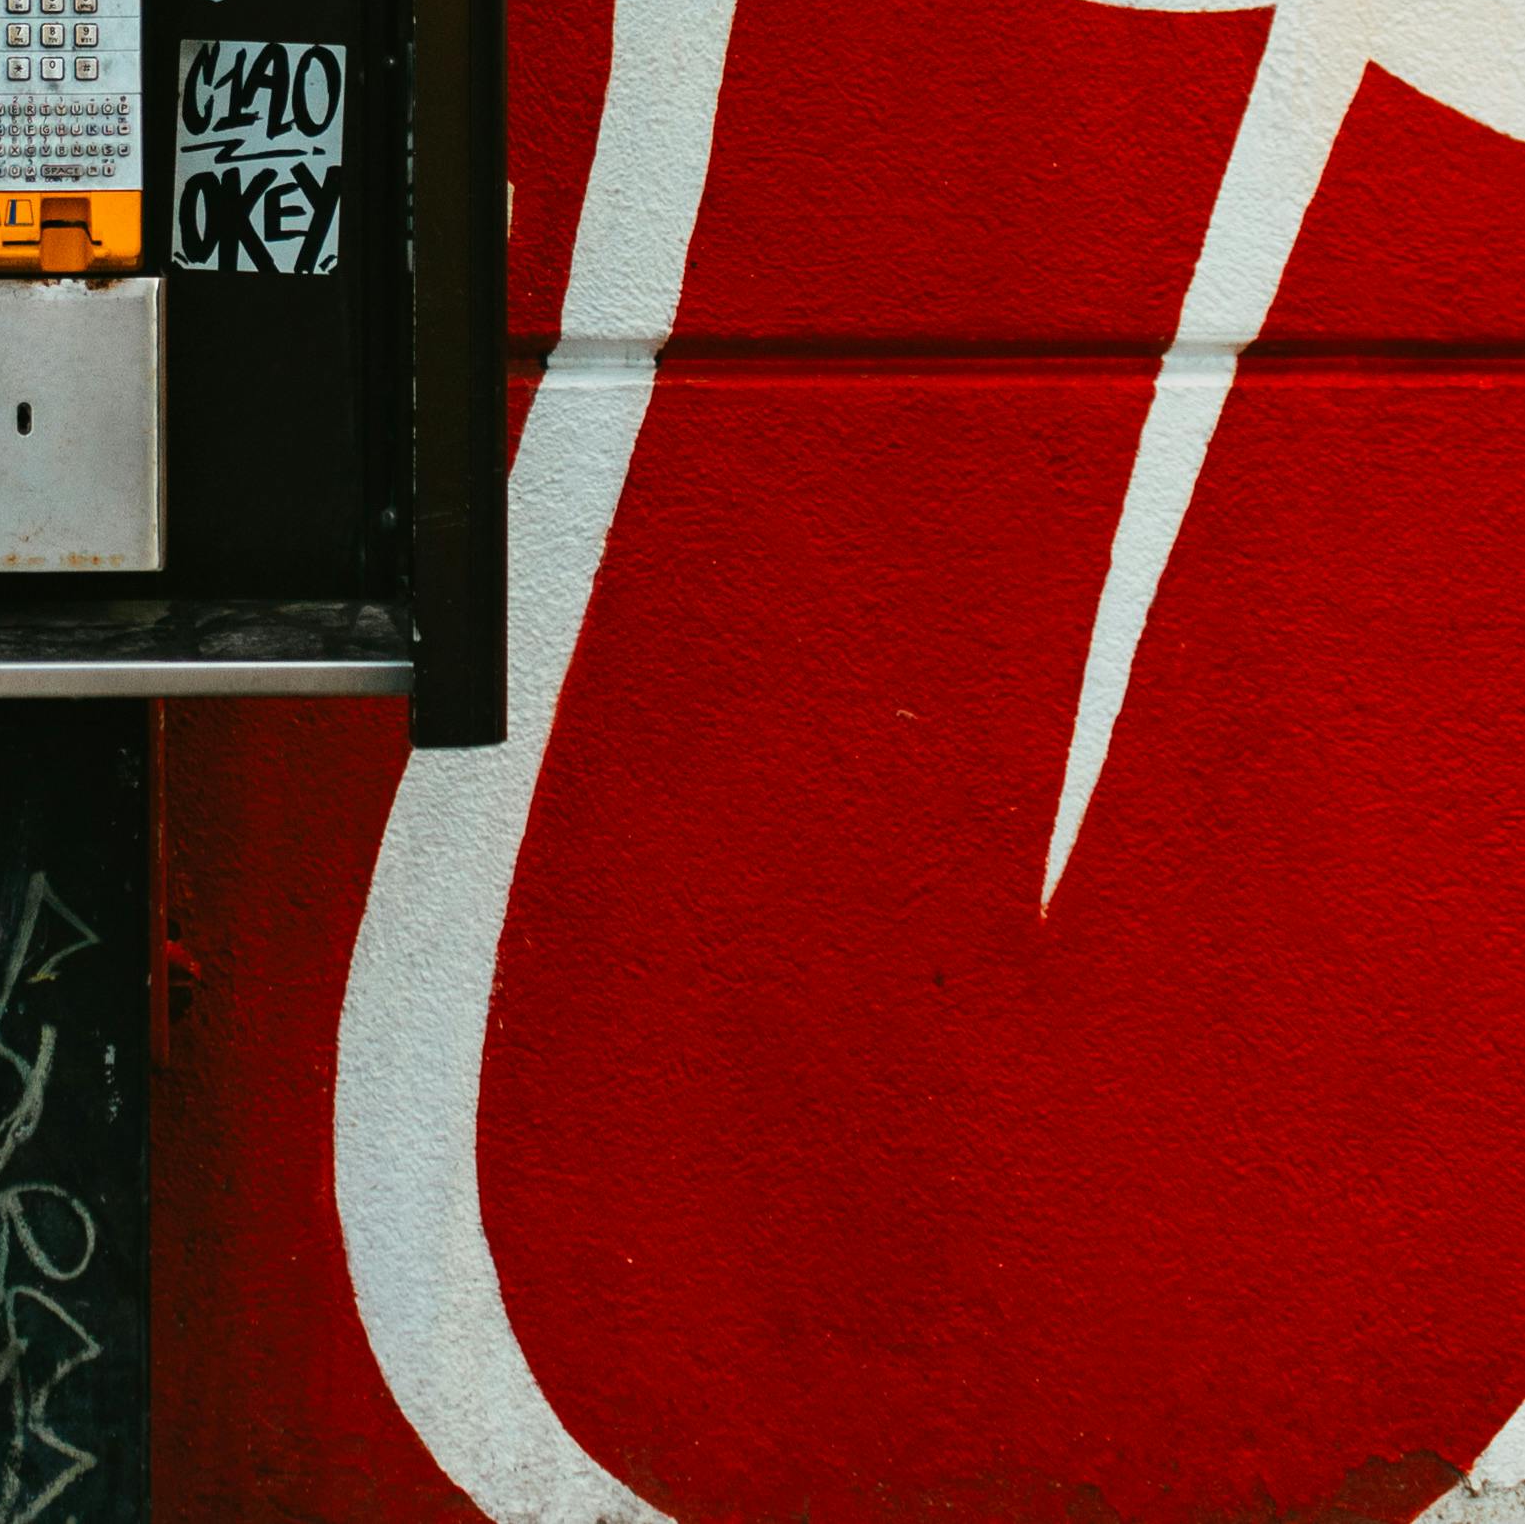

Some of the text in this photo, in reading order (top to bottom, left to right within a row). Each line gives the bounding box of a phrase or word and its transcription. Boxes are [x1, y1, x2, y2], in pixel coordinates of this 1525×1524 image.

[15, 27, 90, 35] 7 8 9
[178, 161, 343, 275] OKEY
